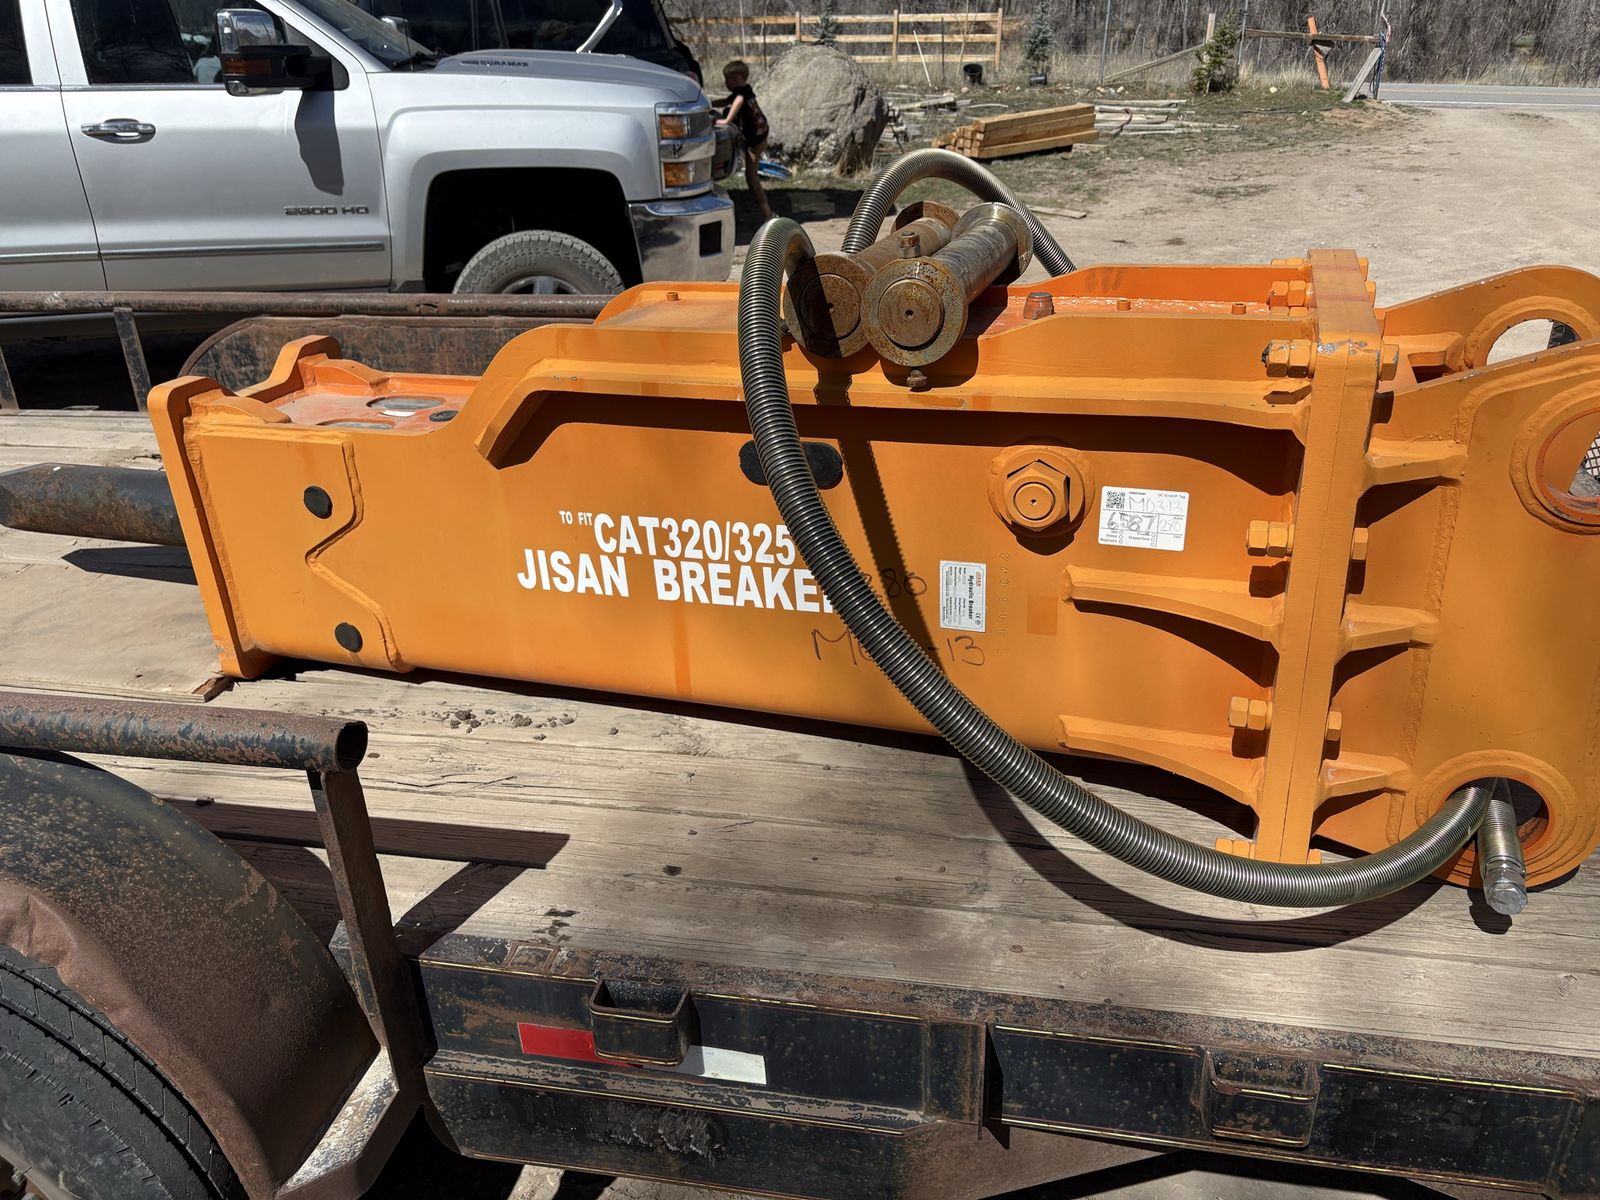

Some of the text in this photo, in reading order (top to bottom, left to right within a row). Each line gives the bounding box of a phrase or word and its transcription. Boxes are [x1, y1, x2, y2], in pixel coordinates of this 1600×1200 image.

[559, 510, 796, 566] TO FIT CAT320/325
[1107, 512, 1156, 532] 6587
[516, 548, 630, 598] JISAN
[967, 575, 975, 599] Hydraulic
